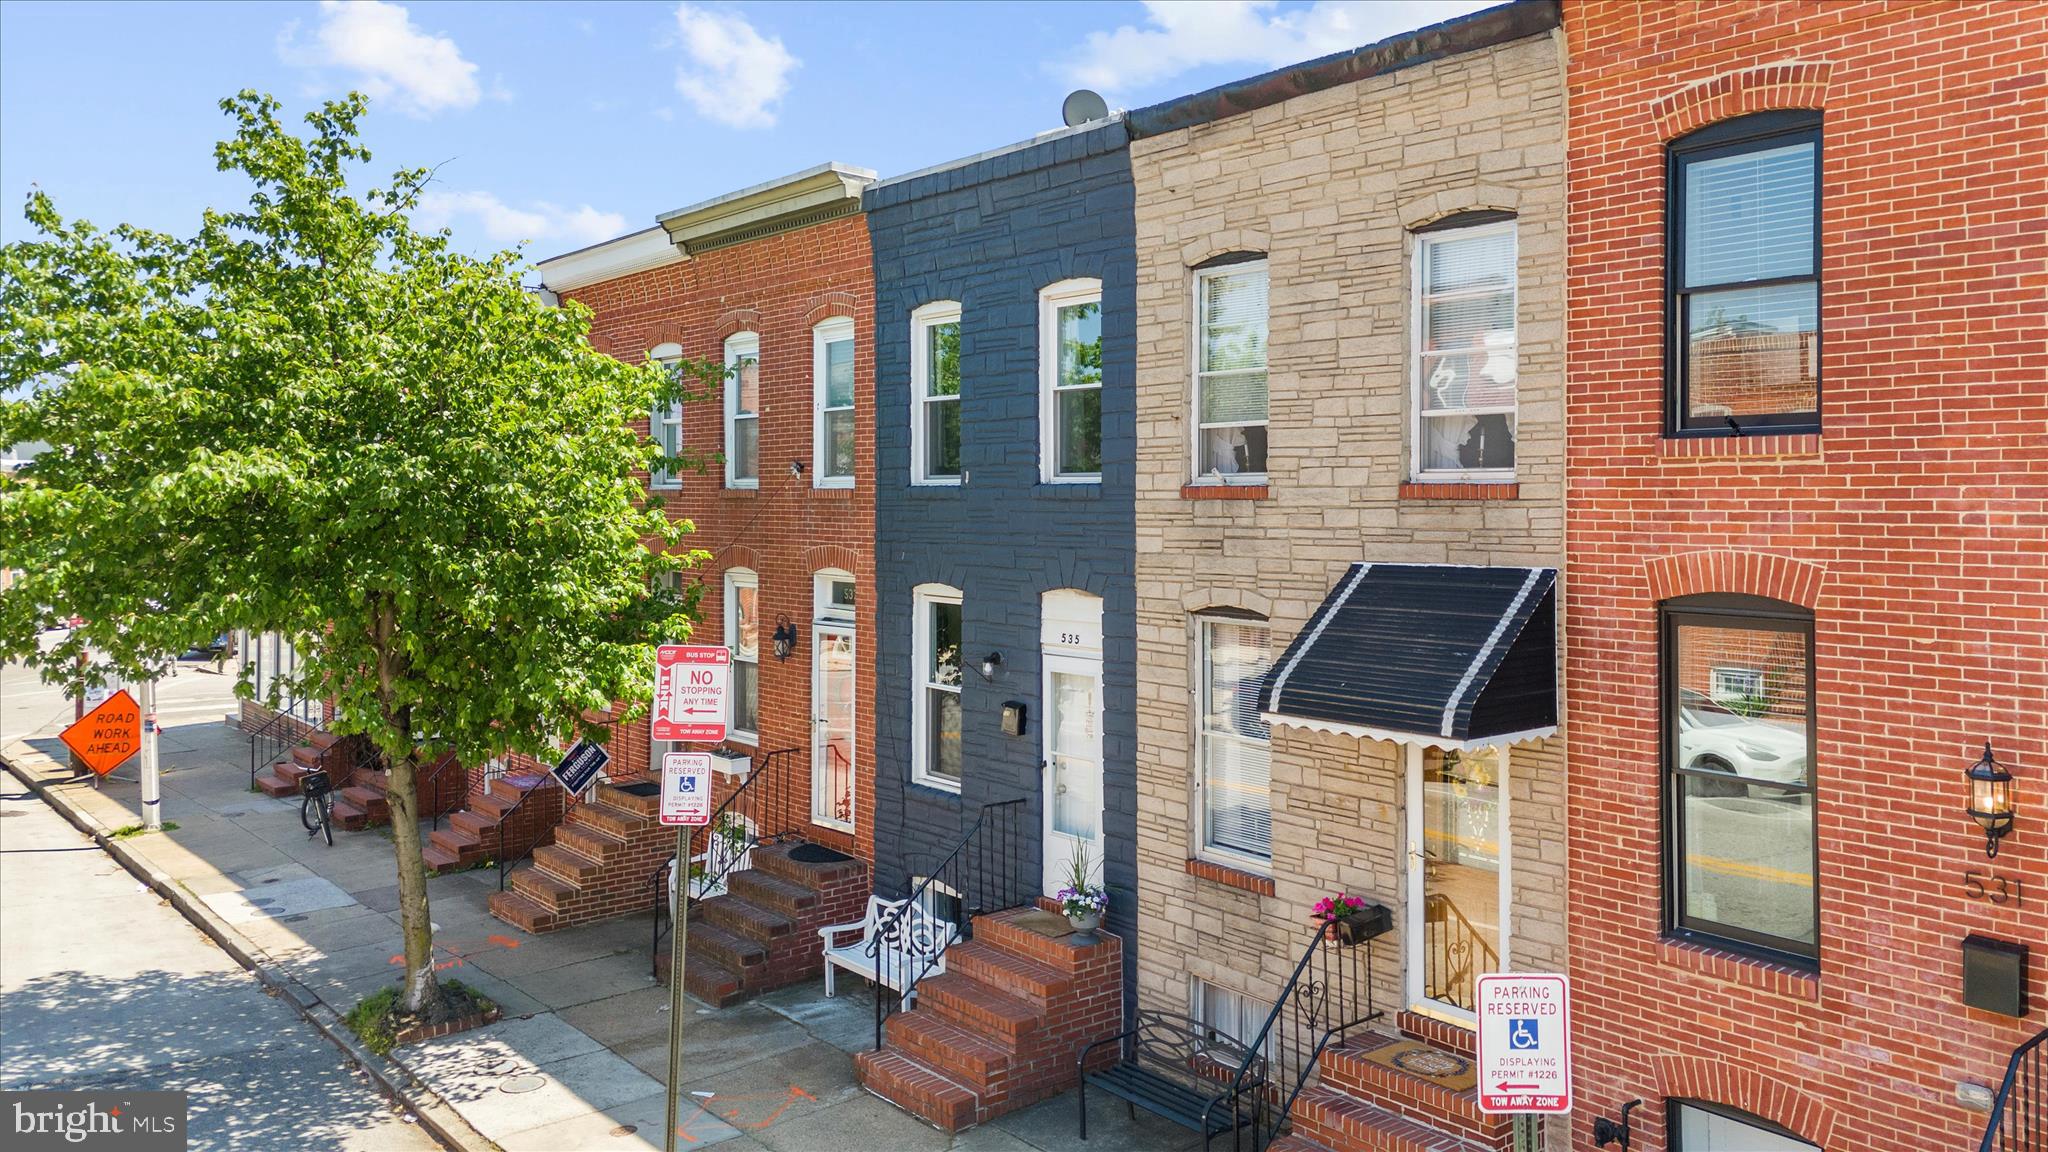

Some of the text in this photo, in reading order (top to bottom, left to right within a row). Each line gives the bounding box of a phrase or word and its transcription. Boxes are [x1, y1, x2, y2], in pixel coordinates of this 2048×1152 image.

[844, 588, 856, 600] 53
[1061, 632, 1080, 644] 535
[690, 670, 713, 684] NO
[680, 686, 722, 694] STOPPING
[96, 713, 135, 724] ROAD
[93, 728, 130, 739] WORK
[86, 742, 130, 754] AHEAD
[562, 745, 596, 780] FERGUSON
[1966, 871, 2021, 908] 531
[1494, 986, 1550, 999] PARKING
[1488, 1003, 1556, 1015] RESERVED
[1500, 1058, 1556, 1066] DISPLAYING
[1492, 1070, 1558, 1080] PERMIT #1226
[1491, 1097, 1559, 1107] TOW AWAY ZONE
